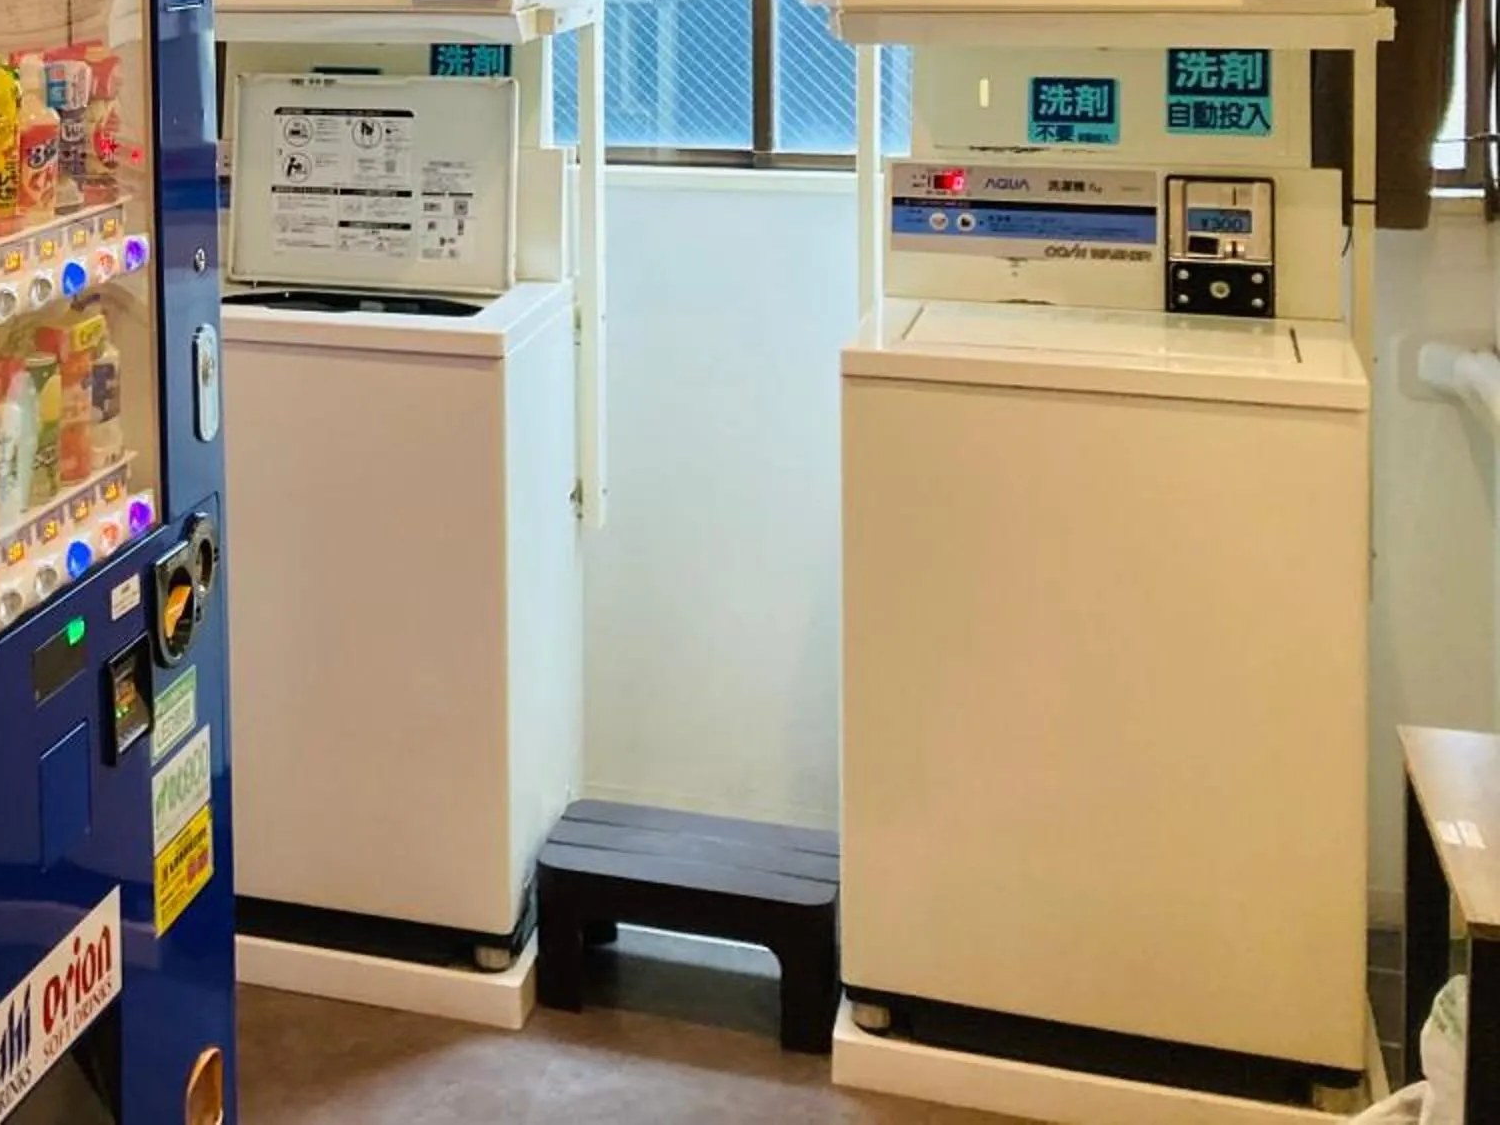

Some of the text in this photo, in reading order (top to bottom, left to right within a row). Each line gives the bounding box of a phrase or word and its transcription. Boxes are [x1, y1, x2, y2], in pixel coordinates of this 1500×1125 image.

[1176, 51, 1263, 90] 洗剤
[1039, 84, 1109, 117] 洗剤
[1168, 101, 1271, 131] 自動投入
[984, 177, 1031, 192] AQUA
[43, 925, 112, 1035] orion
